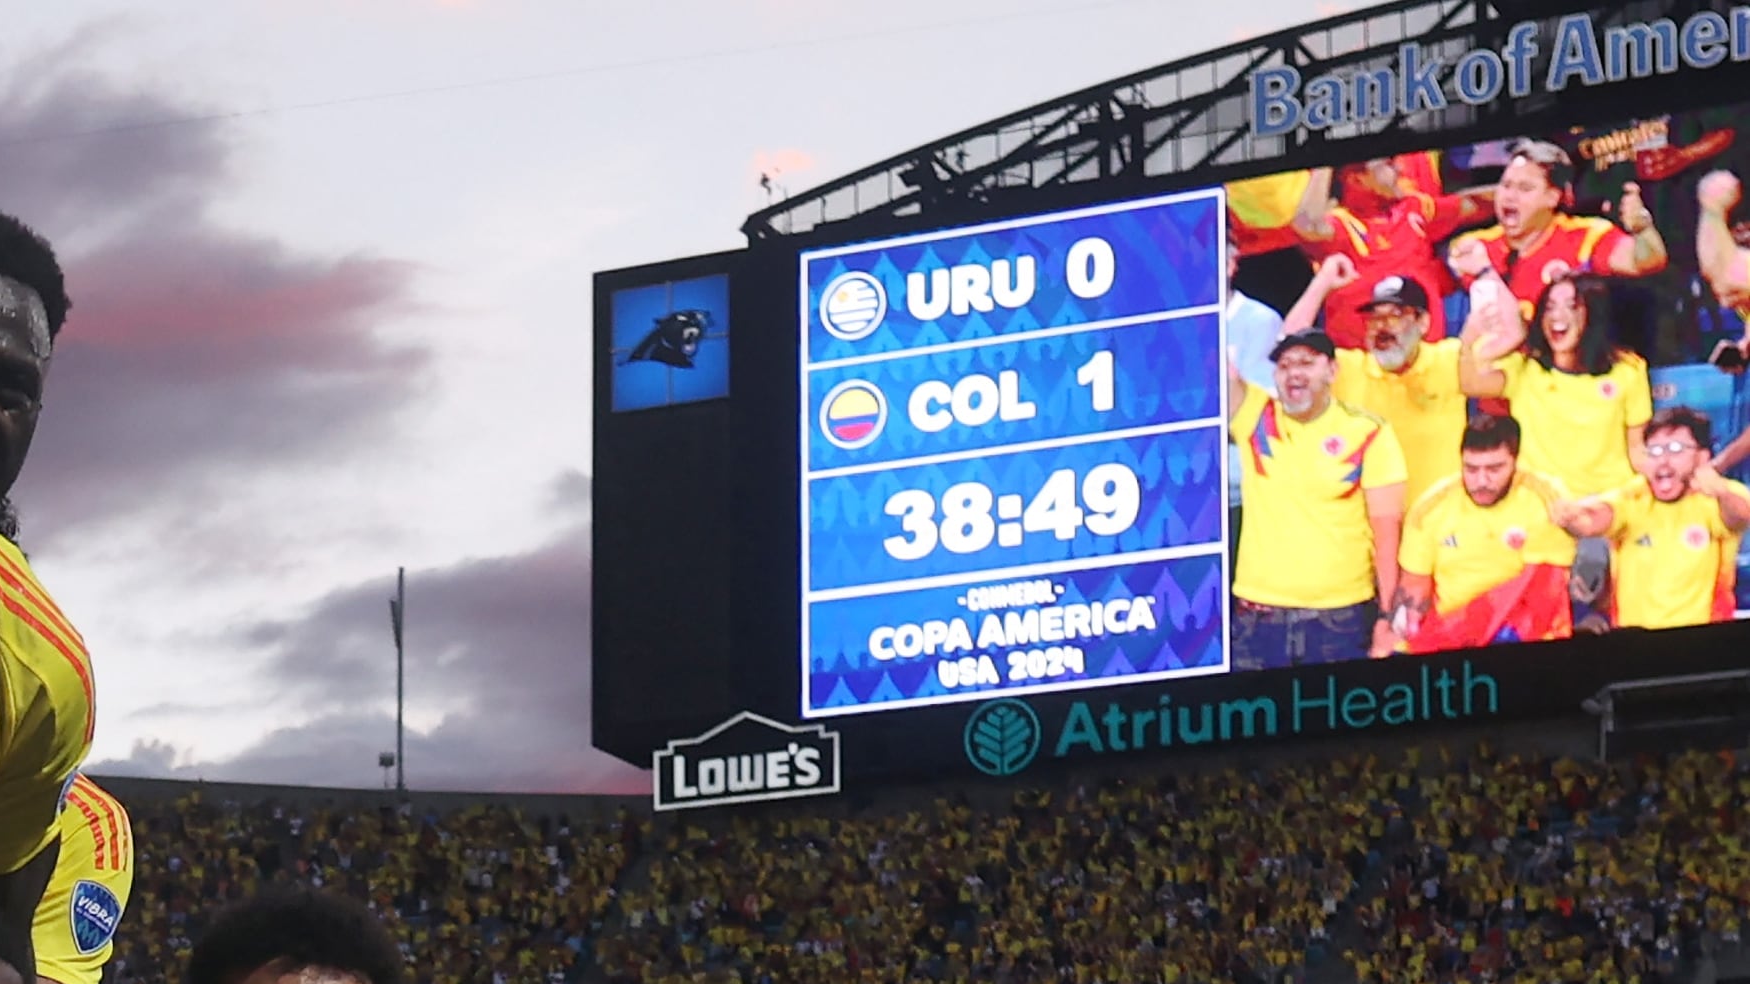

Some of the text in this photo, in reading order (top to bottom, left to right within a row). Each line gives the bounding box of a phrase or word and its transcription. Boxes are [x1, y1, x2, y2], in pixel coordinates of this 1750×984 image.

[1251, 41, 1447, 137] Bank
[1454, 20, 1538, 105] of
[906, 237, 1115, 321] URU 0
[907, 351, 1115, 432] COL 1
[883, 463, 1142, 560] 38:49
[868, 597, 1155, 661] COPA AMERICA
[937, 646, 1084, 688] USA 2024
[1055, 664, 1498, 756] Atrium Health
[673, 743, 821, 799] LOWE'S
[78, 896, 114, 927] VIBRA
